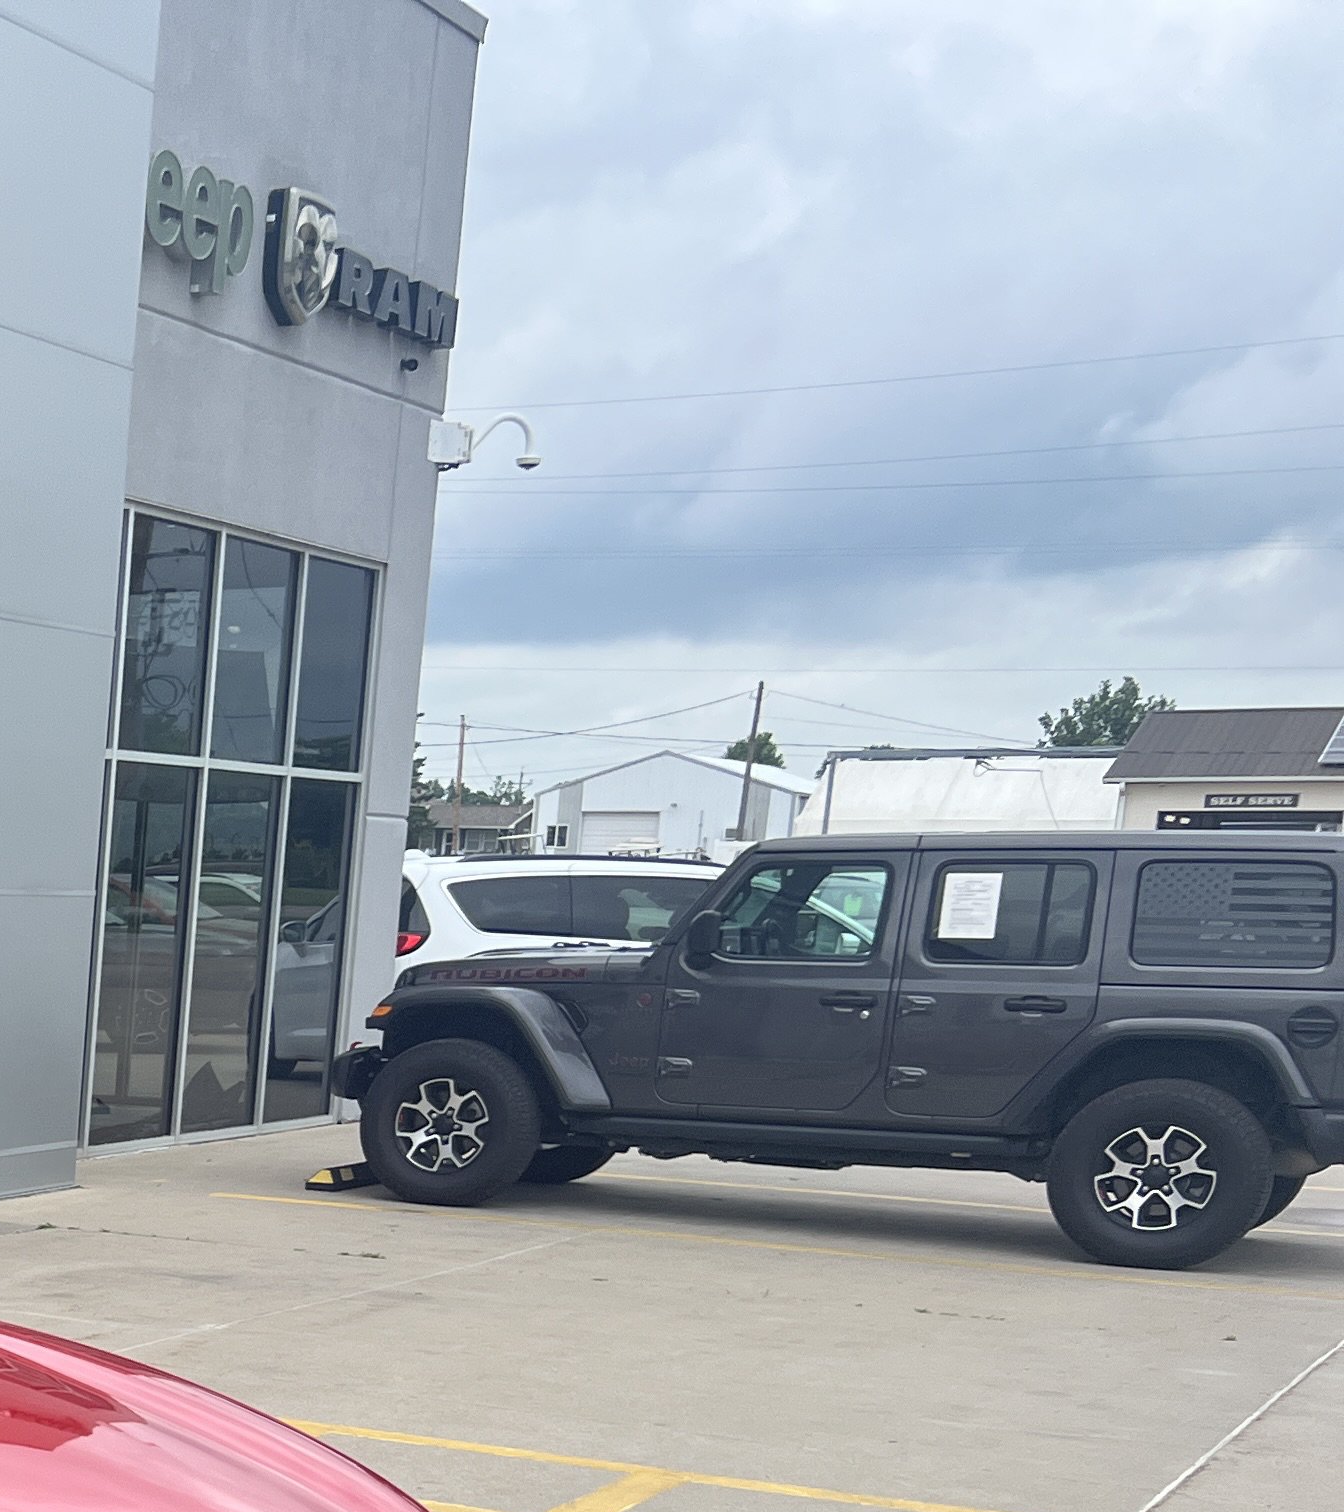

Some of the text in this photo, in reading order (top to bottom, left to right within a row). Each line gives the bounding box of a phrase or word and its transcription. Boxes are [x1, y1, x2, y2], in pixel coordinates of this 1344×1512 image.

[145, 149, 254, 296] eep
[332, 247, 459, 350] RAM
[1210, 796, 1294, 806] SELF SERVE
[429, 966, 587, 981] RUBICON
